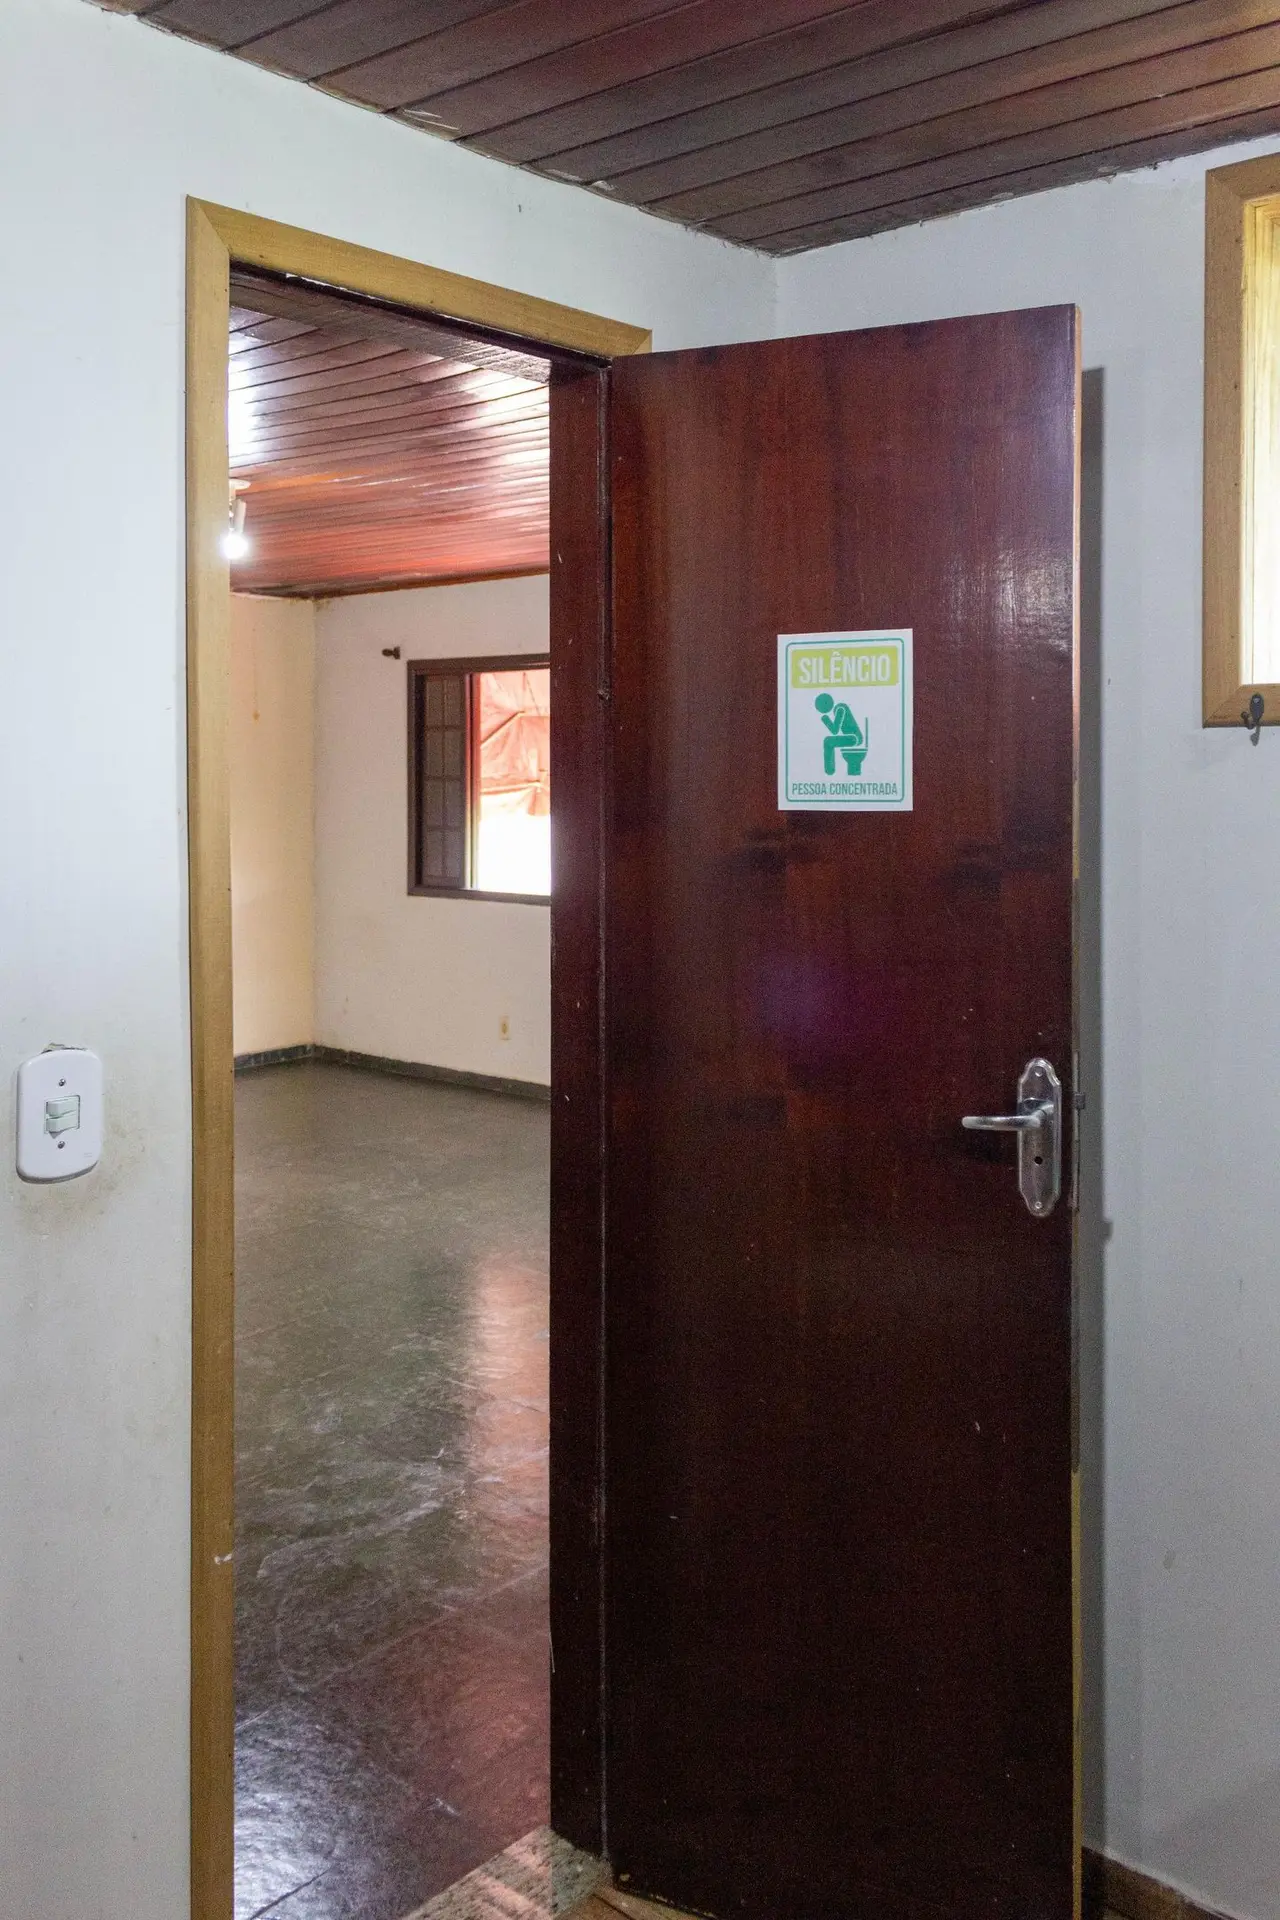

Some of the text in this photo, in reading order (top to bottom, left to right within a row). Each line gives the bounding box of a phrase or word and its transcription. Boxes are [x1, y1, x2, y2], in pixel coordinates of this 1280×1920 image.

[799, 652, 891, 684] SILÊNCIO
[792, 782, 898, 796] PESSOA CONCENTRADA
